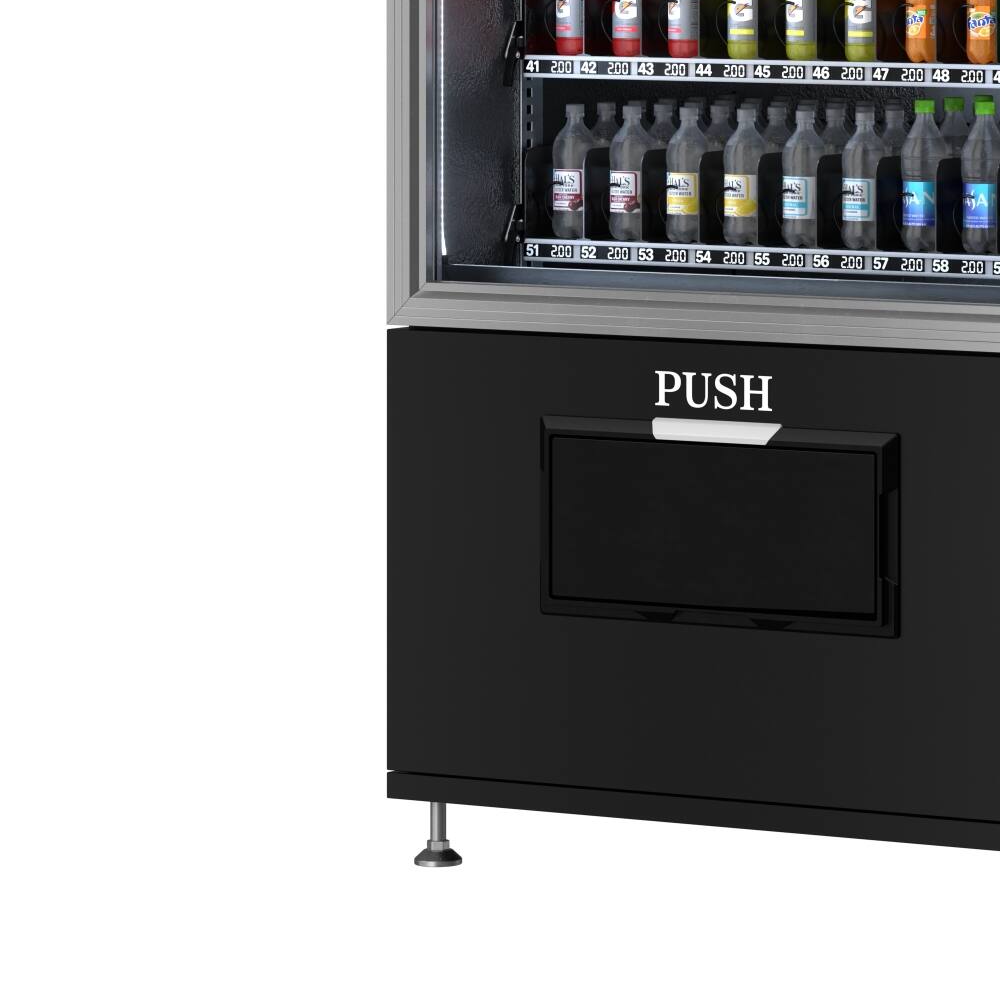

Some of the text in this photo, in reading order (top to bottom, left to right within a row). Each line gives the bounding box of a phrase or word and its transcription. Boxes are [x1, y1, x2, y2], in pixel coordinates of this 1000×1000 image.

[526, 60, 572, 73] 41 2.00
[580, 62, 628, 74] 42 2.00
[638, 62, 686, 76] 43 2.00
[696, 64, 745, 77] 44 2.00
[754, 65, 804, 79] 45 2.00
[812, 66, 863, 80] 46 2.00
[872, 68, 924, 82] 47 2.00
[932, 69, 984, 83] 48 2.00
[526, 244, 572, 258] 51 2.00
[581, 246, 628, 260] 52 2.00
[638, 249, 686, 262] 53 2.00
[696, 250, 744, 264] 54 2.00
[754, 253, 804, 267] 55 2.00
[812, 255, 862, 270] 56 2.00
[872, 258, 923, 272] 57 2.00
[932, 260, 984, 274] 58 2.00
[654, 370, 772, 412] PUSH
